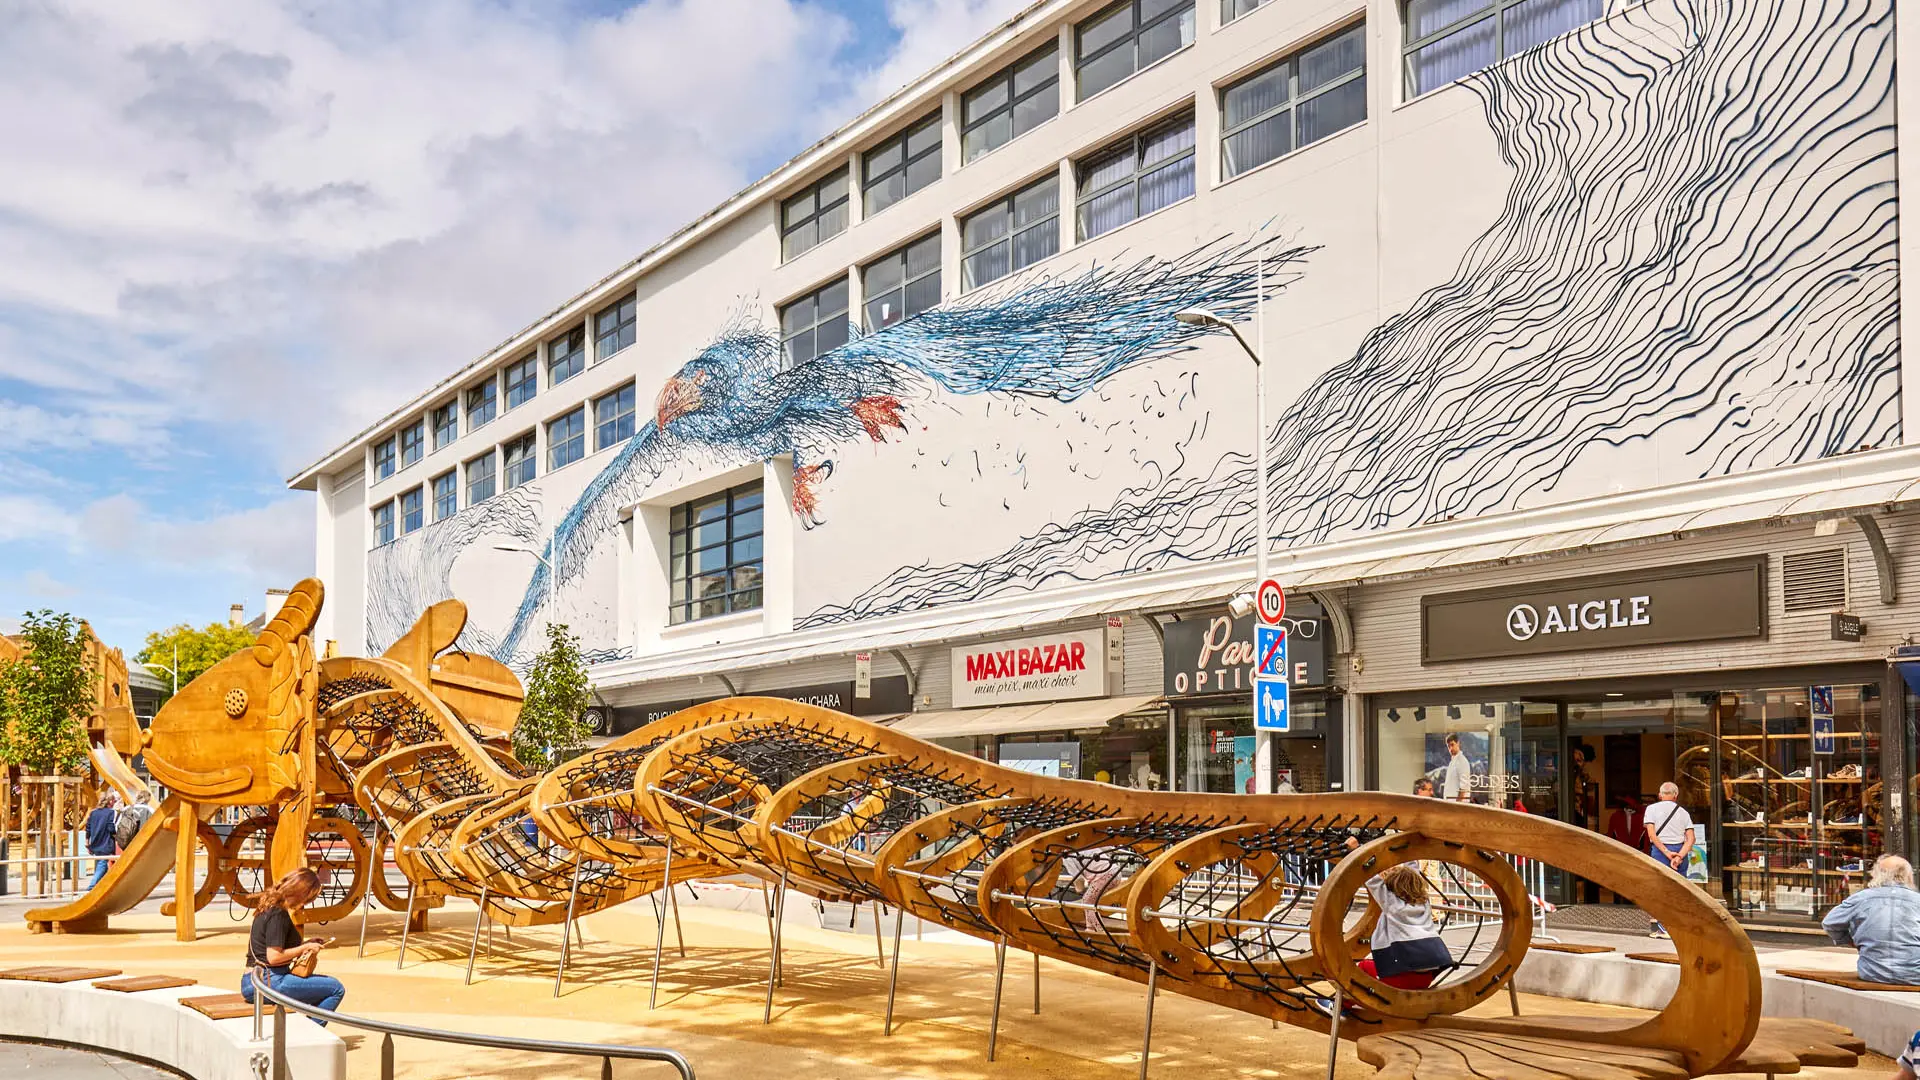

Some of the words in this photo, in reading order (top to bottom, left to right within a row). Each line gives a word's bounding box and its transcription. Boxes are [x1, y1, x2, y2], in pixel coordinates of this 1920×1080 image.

[1264, 593, 1279, 611] 10
[1541, 596, 1650, 635] AIGLE
[1843, 622, 1859, 632] AIGLE
[966, 649, 1016, 682] MAXI
[1018, 641, 1086, 676] BAZAR
[974, 682, 996, 695] mini
[1022, 677, 1050, 690] maxi
[1051, 673, 1078, 688] choix
[1175, 661, 1308, 694] OPTIE
